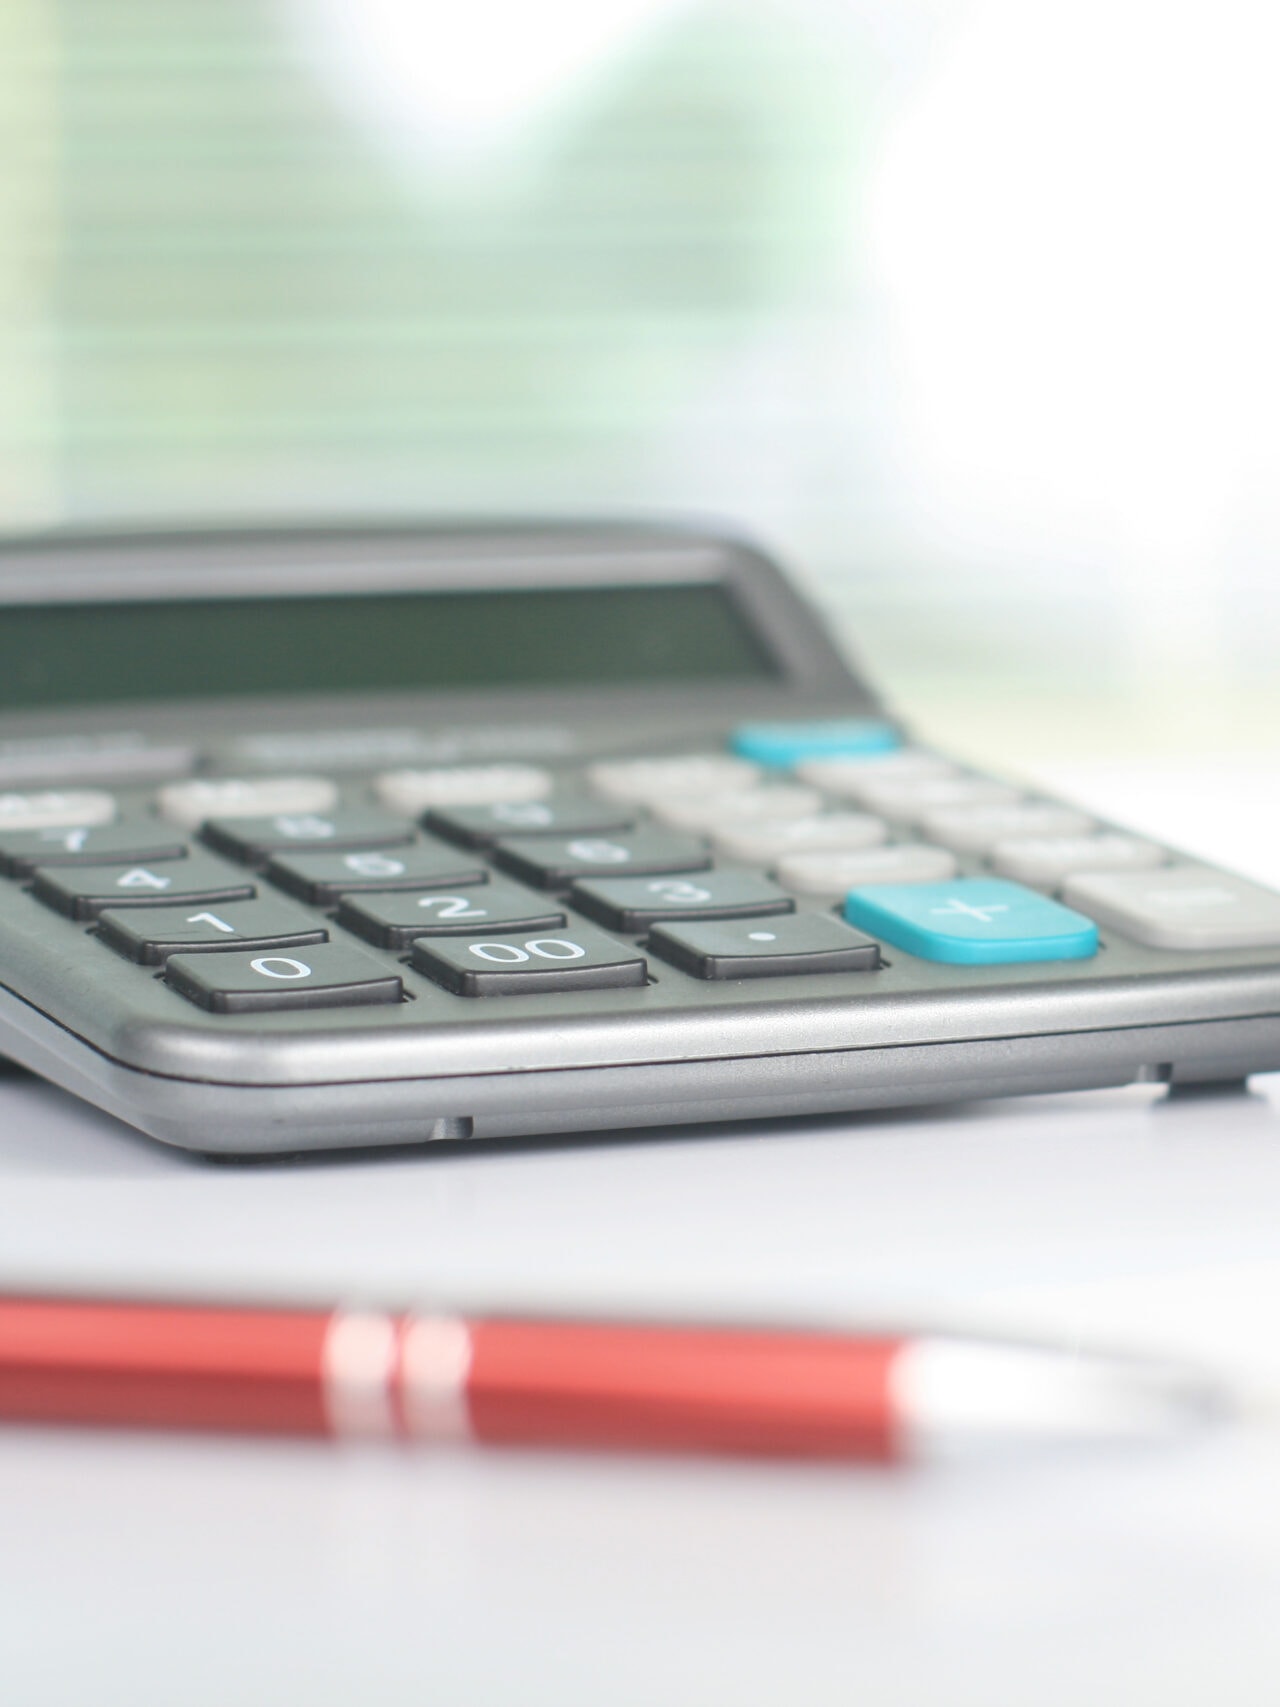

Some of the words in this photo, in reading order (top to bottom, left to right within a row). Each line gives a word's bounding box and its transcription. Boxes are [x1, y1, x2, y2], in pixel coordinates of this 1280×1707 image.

[117, 868, 171, 889] 4
[648, 881, 711, 902] 3
[418, 896, 487, 918] 2
[187, 912, 234, 932] 1
[468, 938, 586, 963] 00
[250, 957, 311, 979] 0
